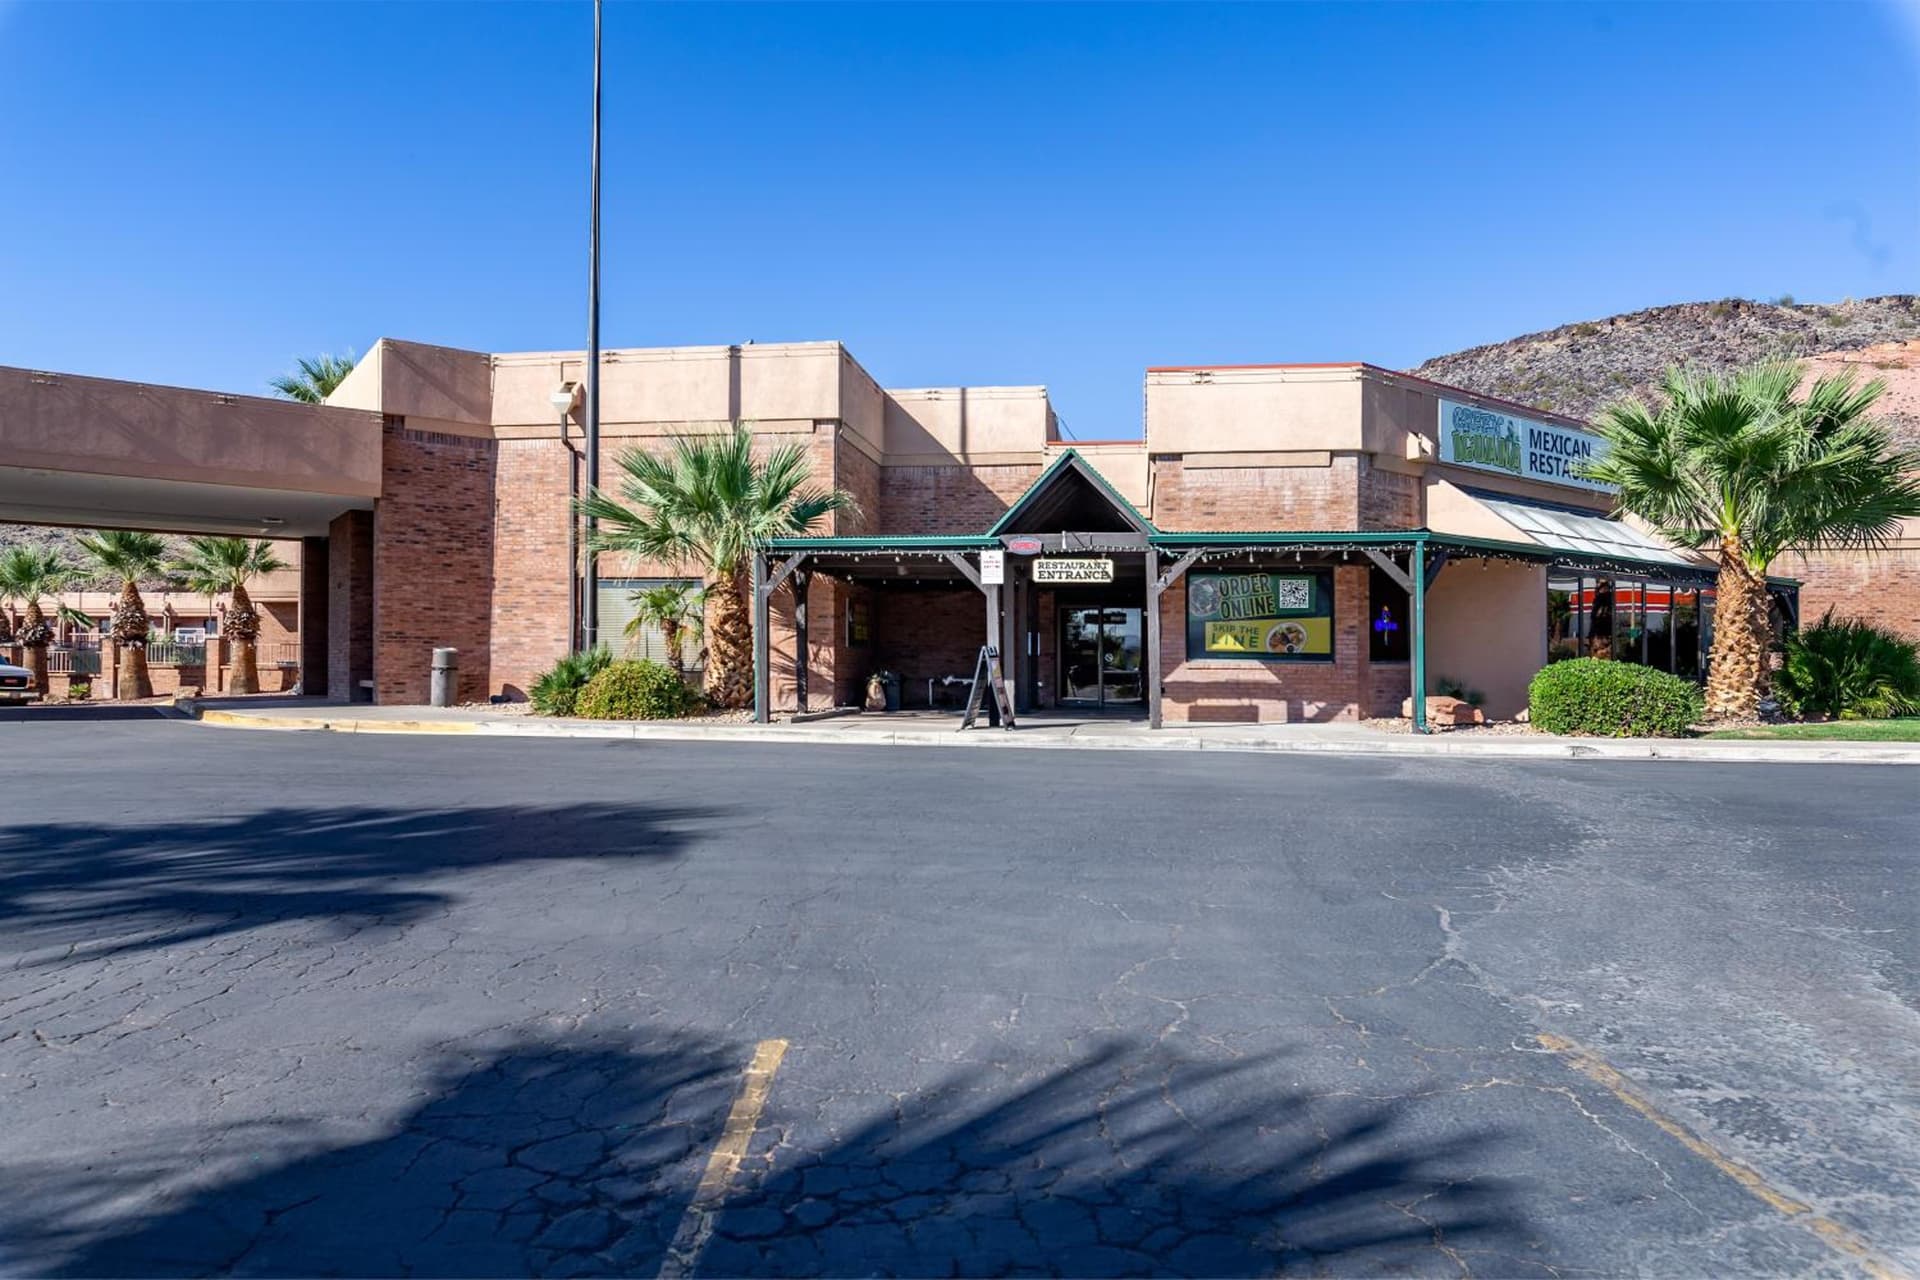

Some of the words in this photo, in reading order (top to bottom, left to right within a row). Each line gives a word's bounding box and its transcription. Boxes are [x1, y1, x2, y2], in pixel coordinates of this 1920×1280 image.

[1529, 428, 1591, 458] MEXICAN
[1038, 562, 1109, 570] RESTAURANT
[1037, 570, 1112, 580] ENTRANCE
[1219, 574, 1271, 598] ORDER
[1221, 595, 1275, 619] ONLINE
[1212, 623, 1236, 633] SKIP
[1239, 626, 1260, 636] THE
[1211, 632, 1259, 648] LINE
